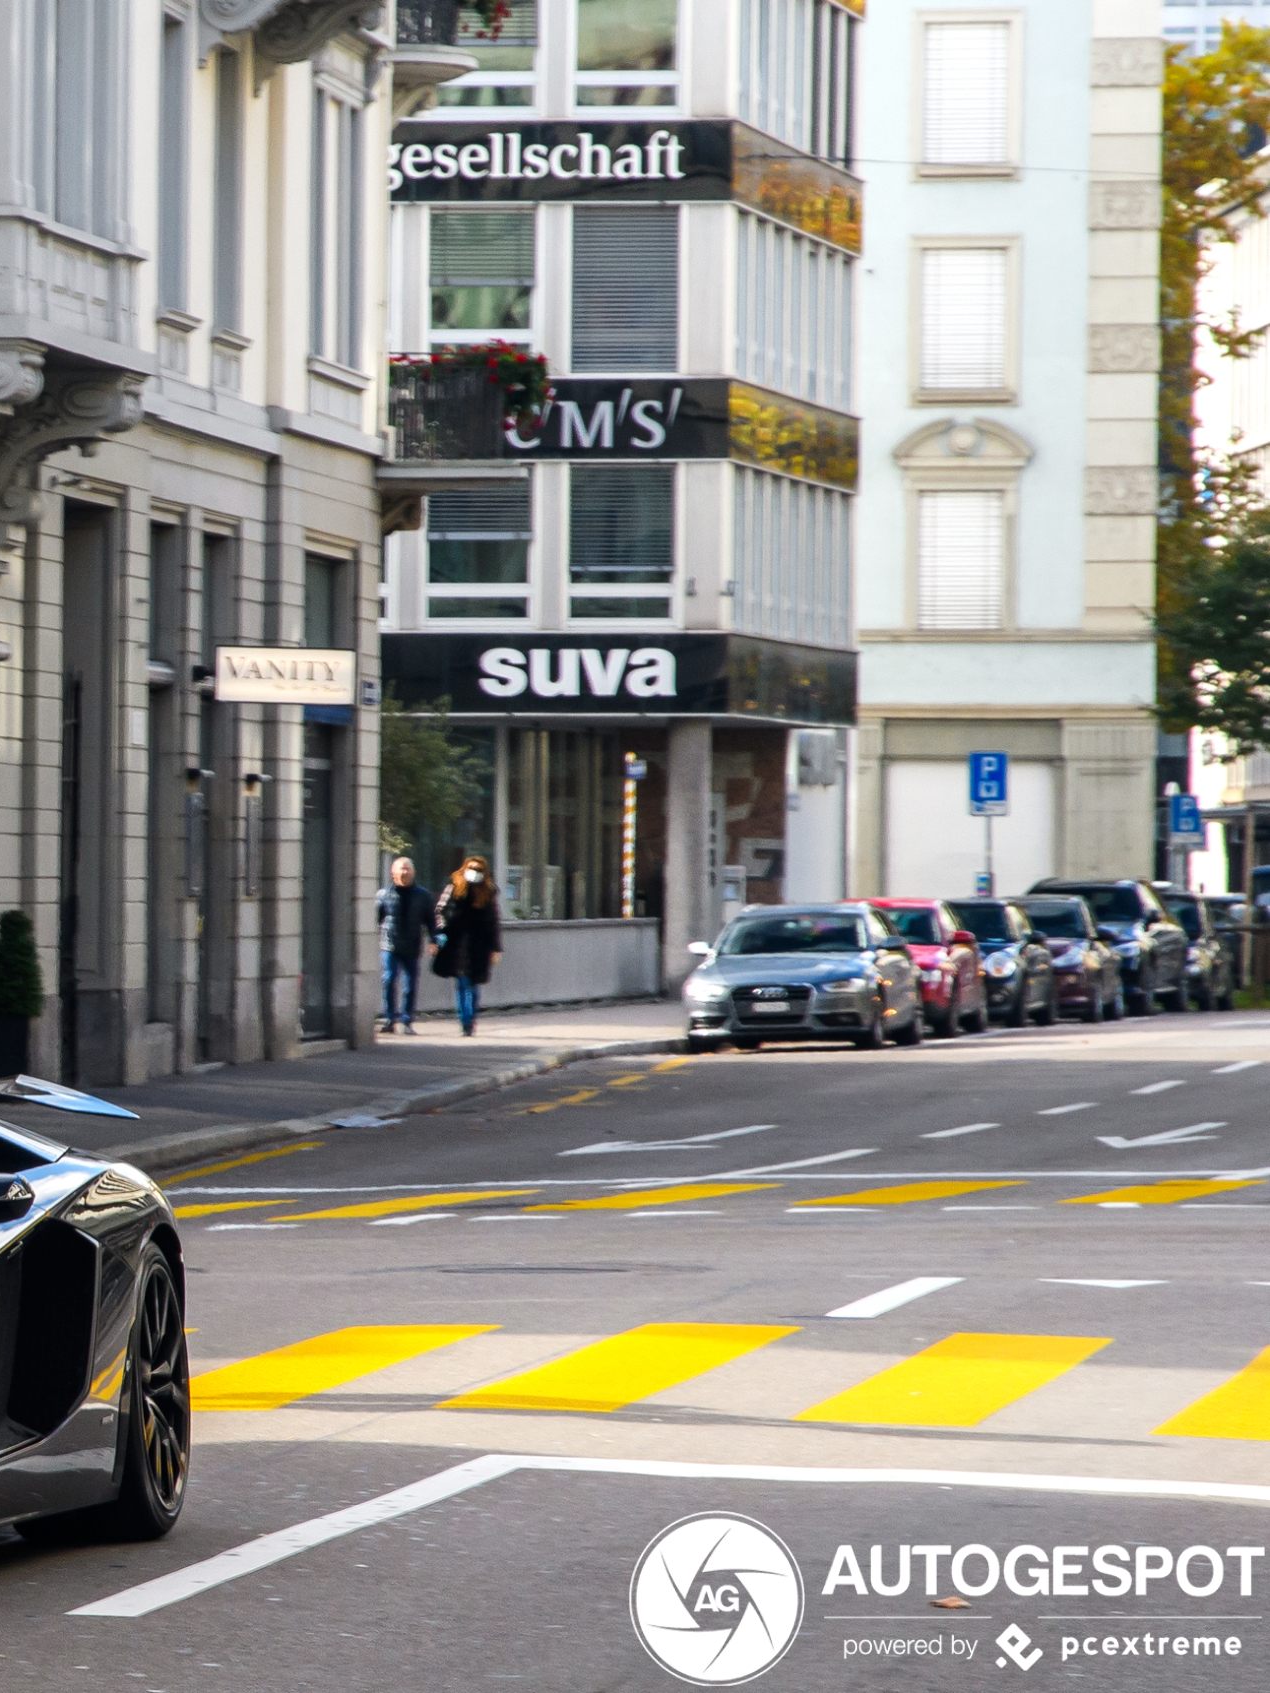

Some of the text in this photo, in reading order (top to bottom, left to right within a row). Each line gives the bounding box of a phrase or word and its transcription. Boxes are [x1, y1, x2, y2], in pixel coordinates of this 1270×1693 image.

[386, 130, 685, 190] gesellschaft
[224, 656, 341, 682] VANITY
[477, 646, 678, 698] suva
[981, 756, 998, 779] P
